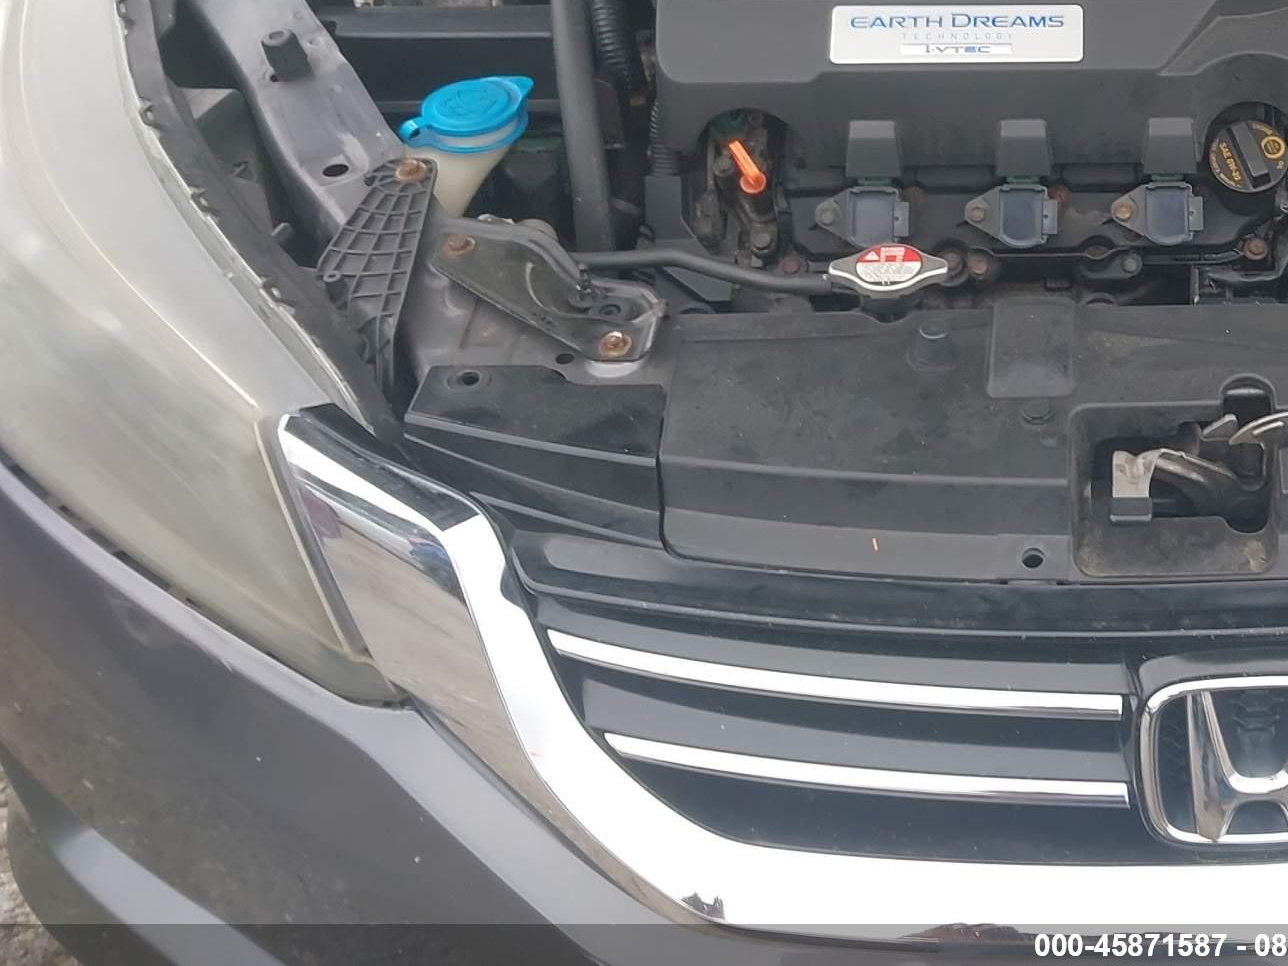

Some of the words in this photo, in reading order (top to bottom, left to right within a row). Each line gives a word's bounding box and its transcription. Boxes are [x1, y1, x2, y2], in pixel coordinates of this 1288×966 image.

[850, 15, 943, 29] EARTH
[951, 13, 1065, 29] DREAMS
[902, 32, 1014, 41] TECHNOLOGY
